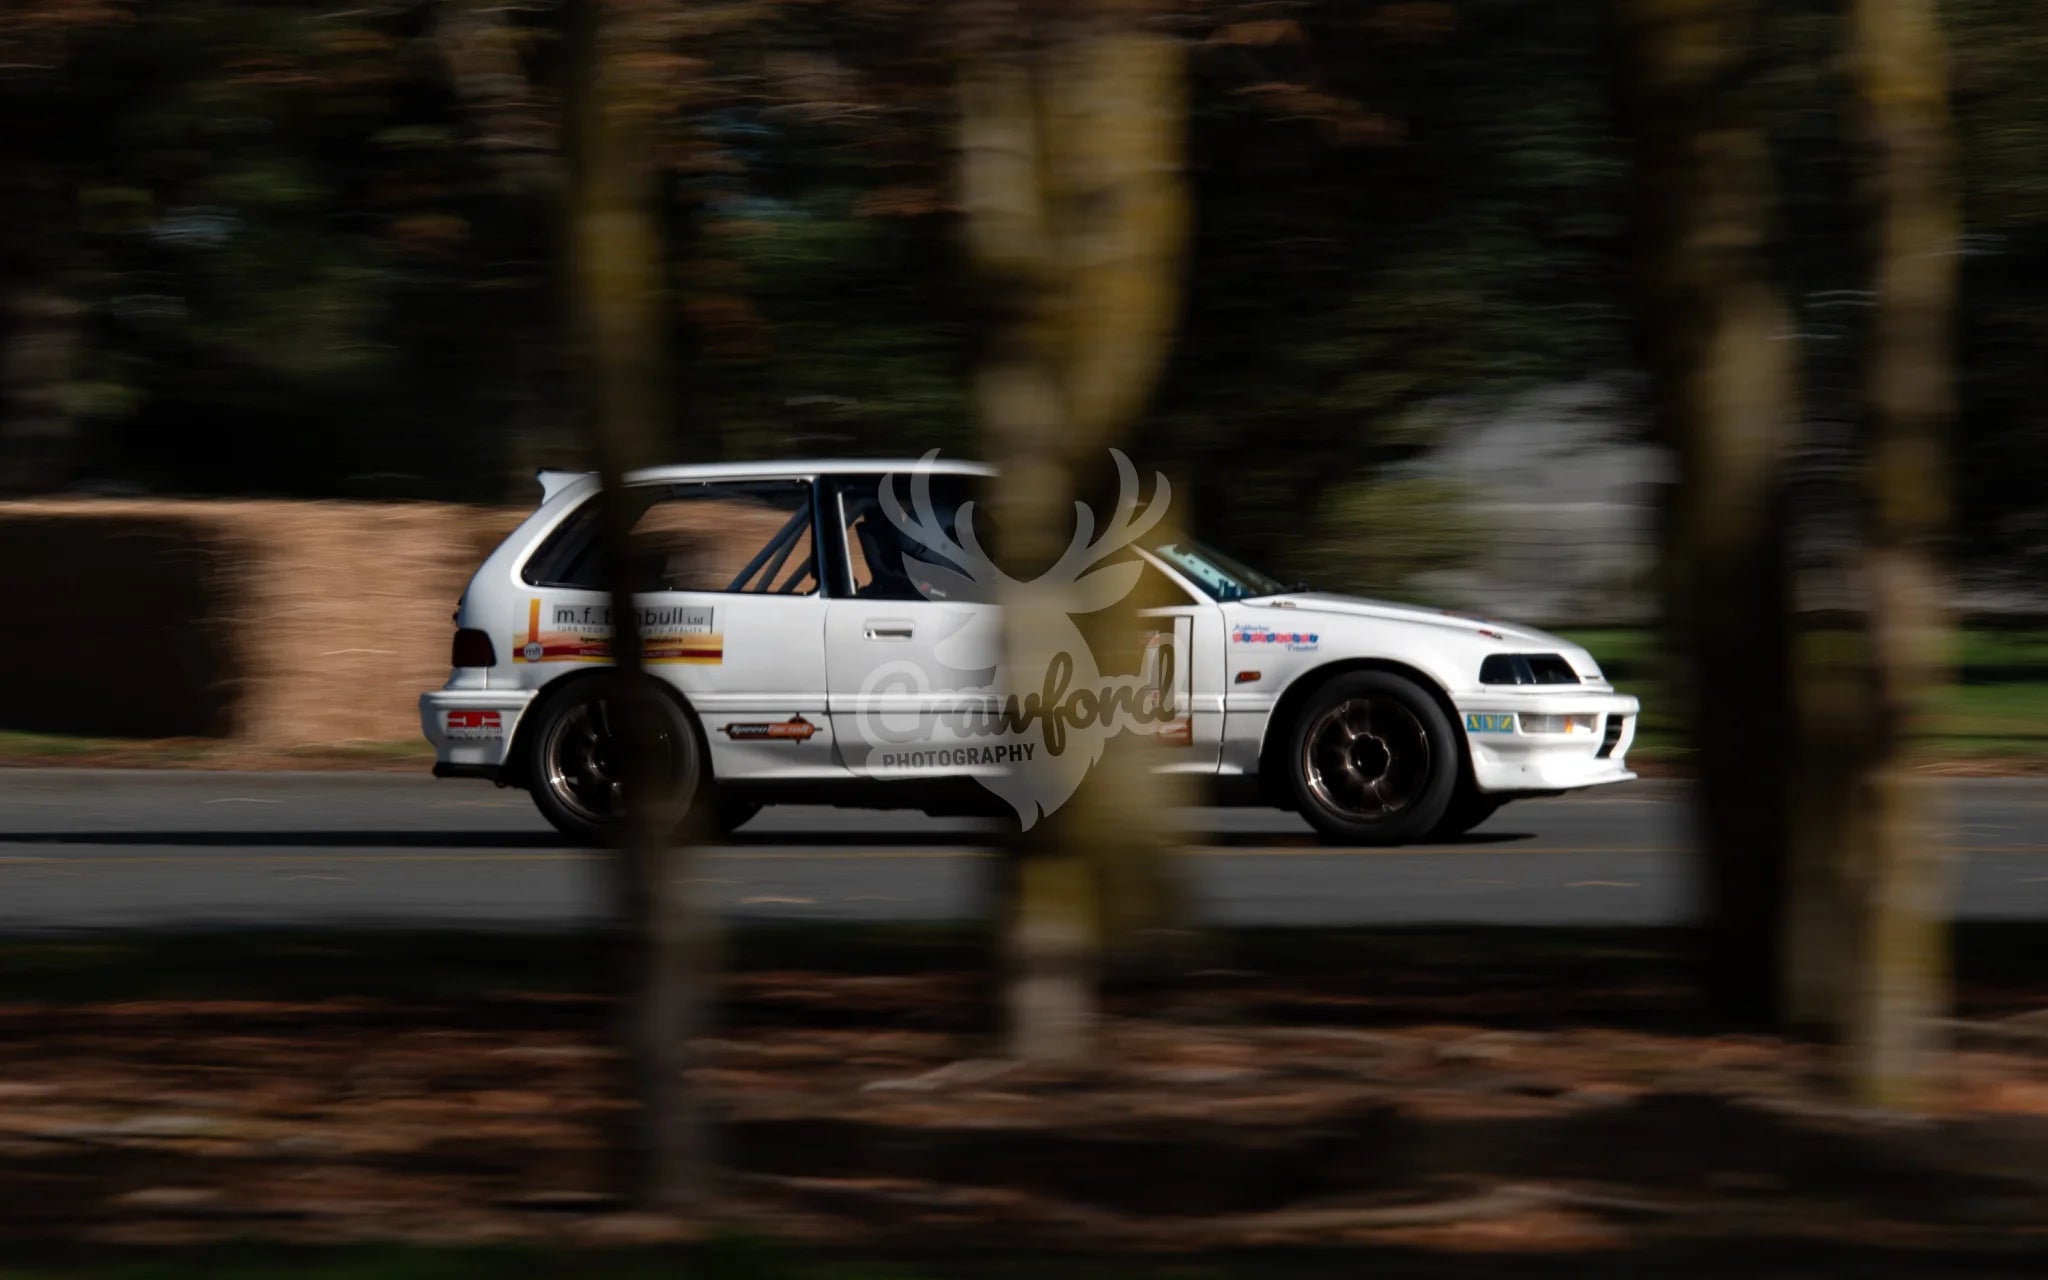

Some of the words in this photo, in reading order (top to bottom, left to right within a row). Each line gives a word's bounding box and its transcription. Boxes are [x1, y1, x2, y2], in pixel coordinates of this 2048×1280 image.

[557, 607, 596, 624] m.f.
[688, 616, 704, 625] Ltd
[1469, 715, 1512, 729] XYZ
